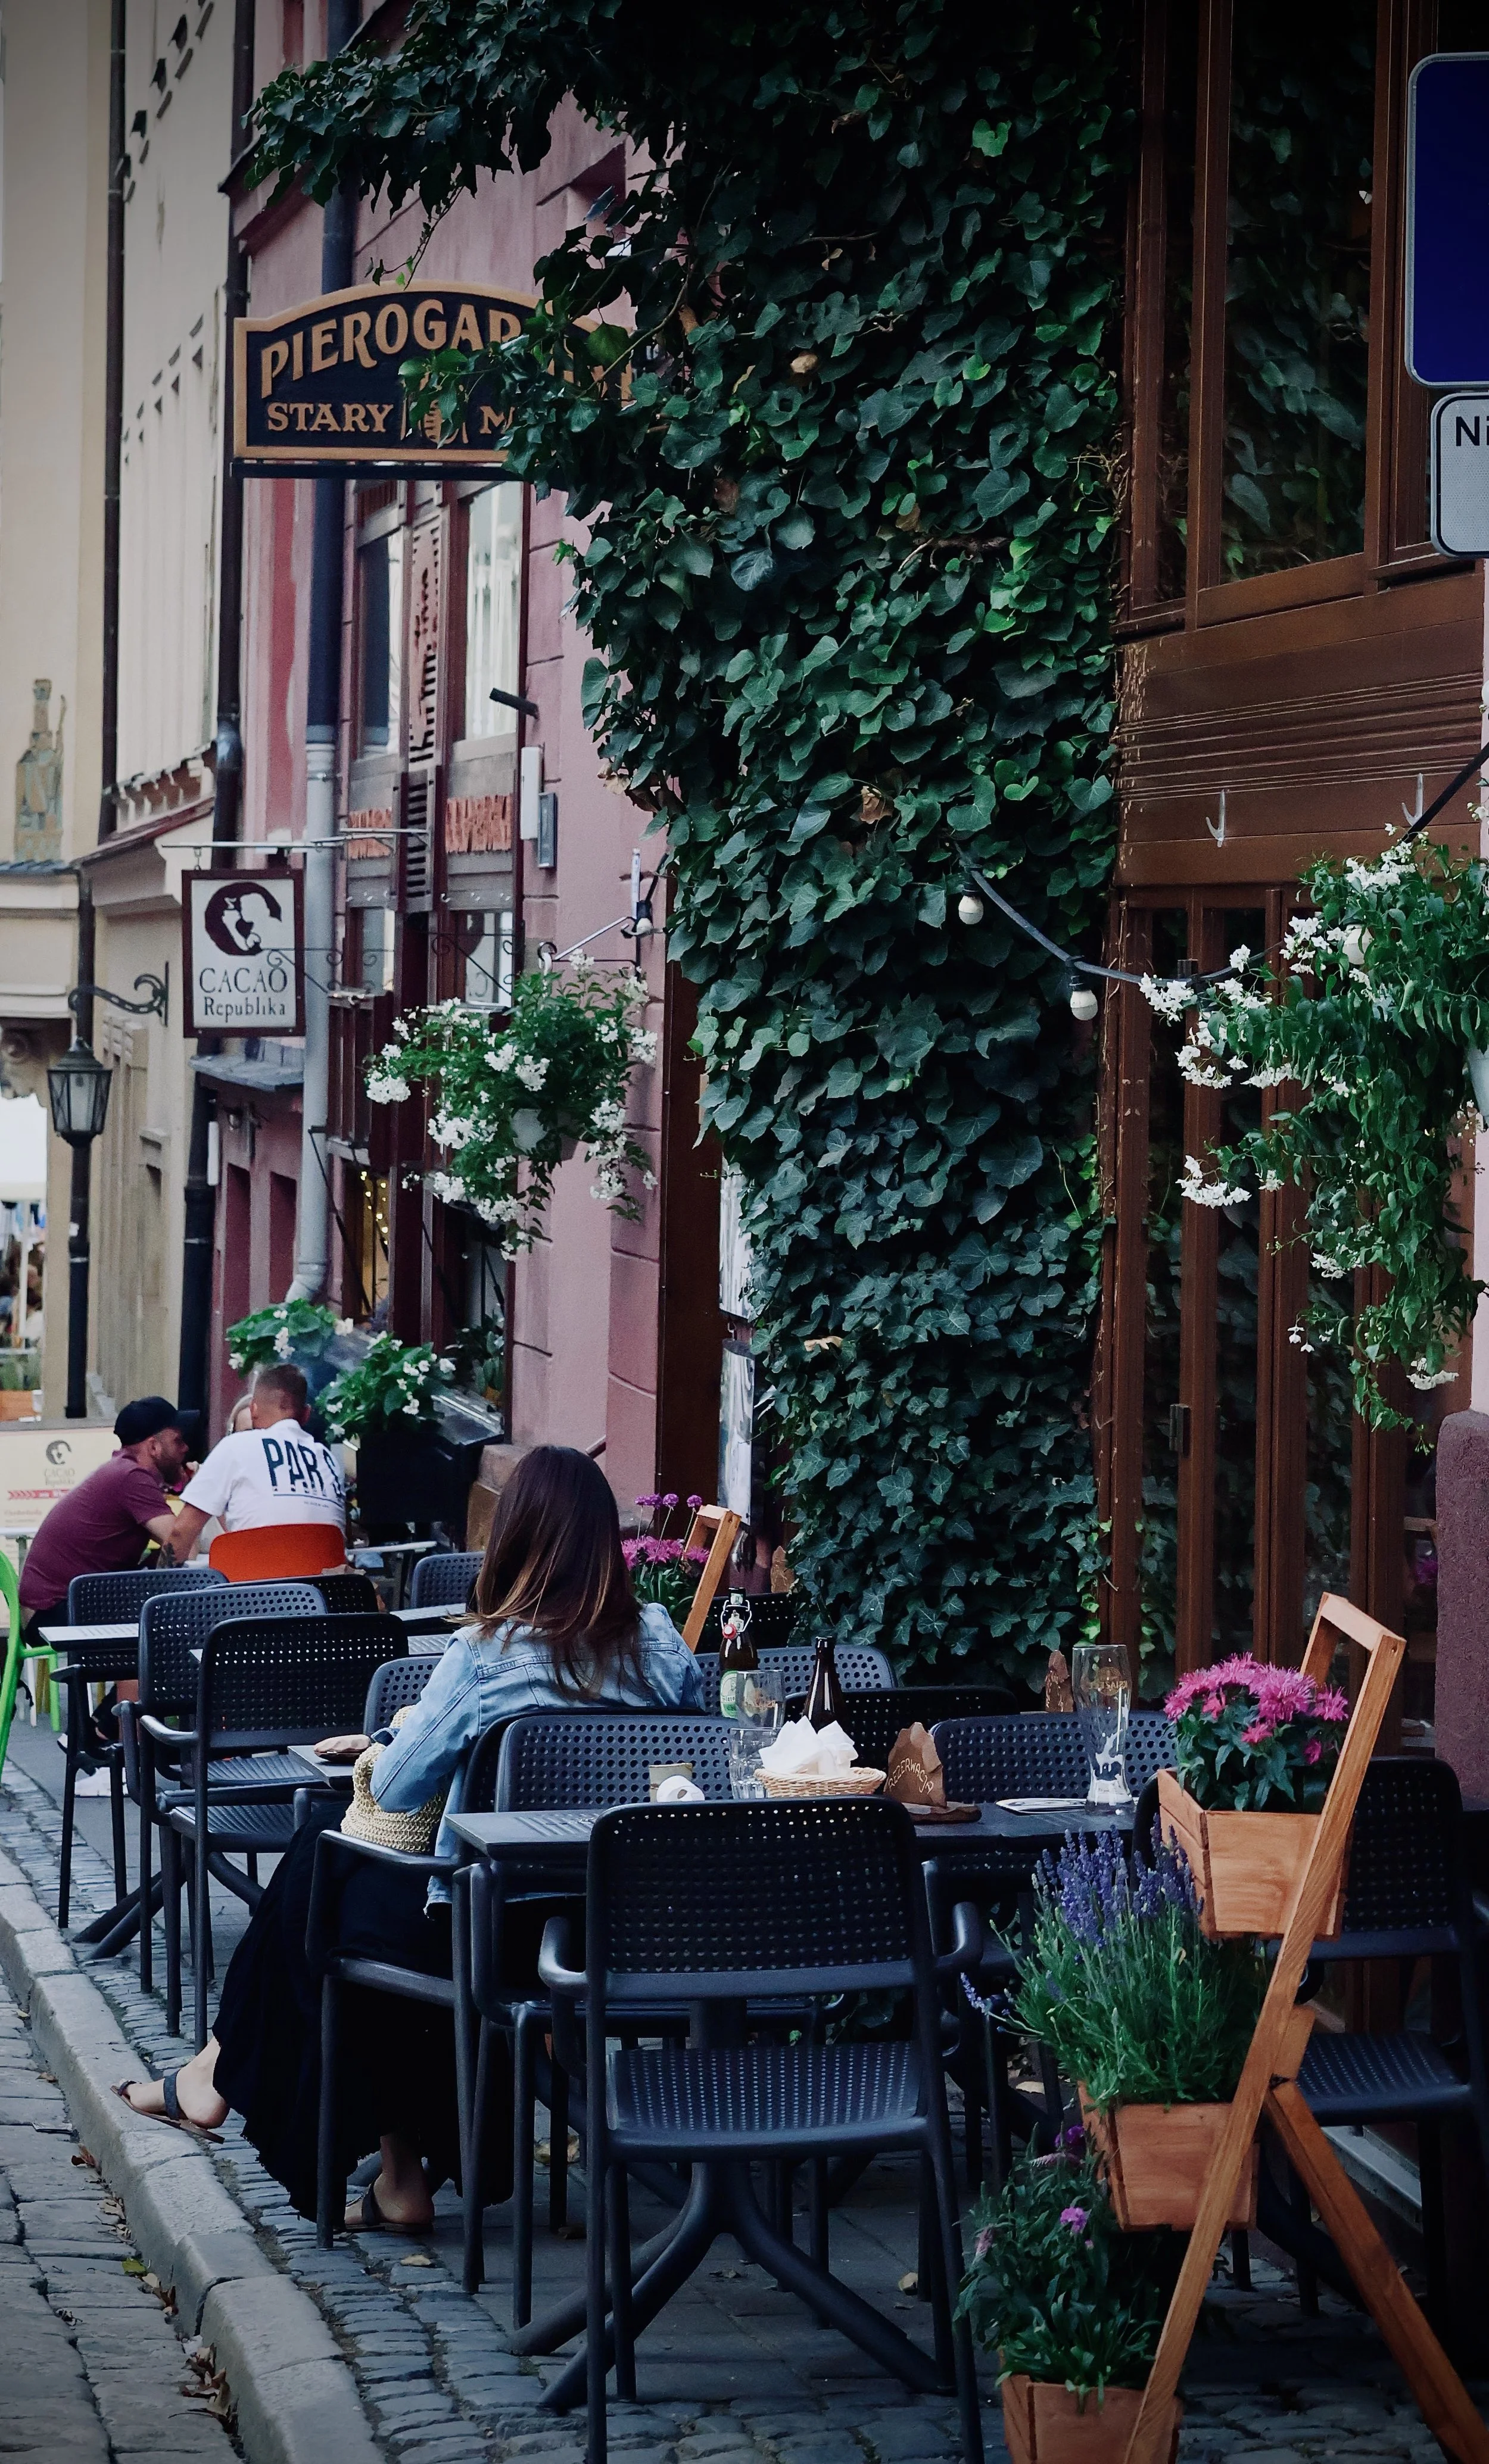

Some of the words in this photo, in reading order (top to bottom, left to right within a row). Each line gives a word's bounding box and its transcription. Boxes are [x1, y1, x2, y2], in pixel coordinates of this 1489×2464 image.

[267, 403, 393, 433] STARY
[200, 968, 287, 993] CACAO
[204, 996, 285, 1023] Republika
[888, 1758, 934, 1795] REZERWACJA
